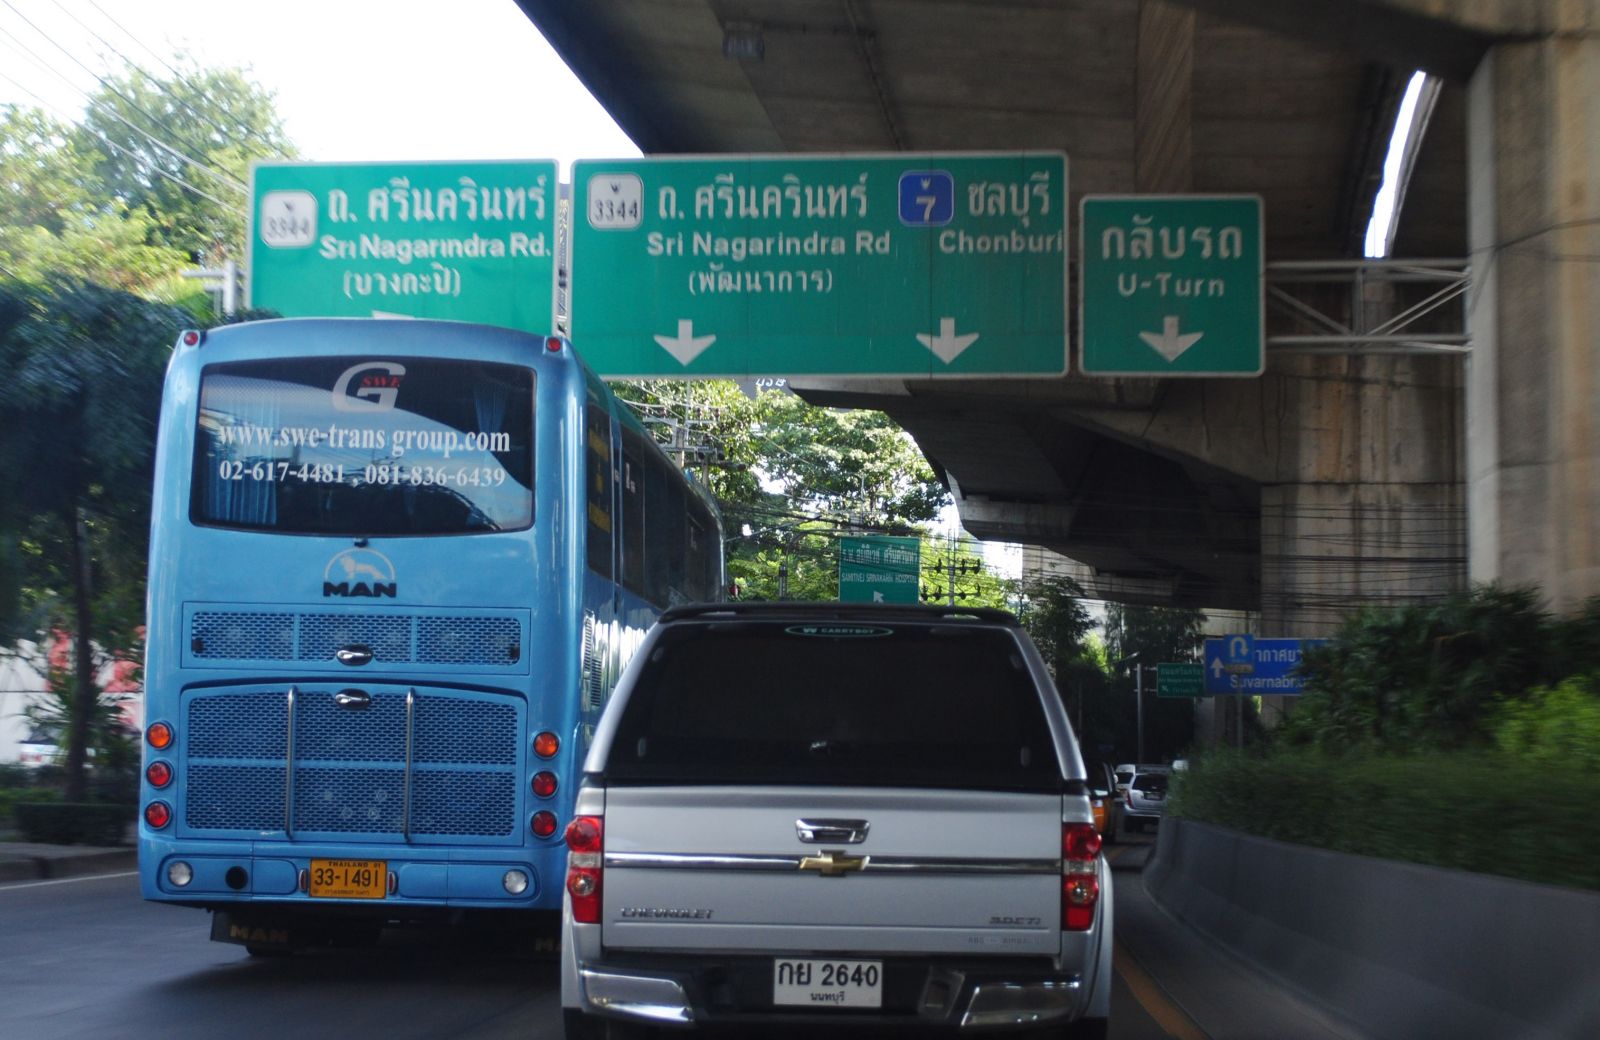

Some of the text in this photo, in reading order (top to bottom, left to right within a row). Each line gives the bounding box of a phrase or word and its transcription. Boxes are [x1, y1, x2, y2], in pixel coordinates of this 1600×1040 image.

[328, 174, 547, 223] ถ. ศรีนครินทร์
[595, 199, 639, 221] 3344
[658, 172, 868, 220] ถ. ศรีนครินทร์
[915, 195, 937, 223] 7
[967, 170, 1051, 227] ชลบุรี
[266, 215, 310, 241] 3344
[939, 230, 1064, 254] Chonburi
[1102, 213, 1243, 260] กลับรถ
[319, 231, 551, 265] Sri Nagarindra Rd.
[647, 230, 890, 261] Sri Nagarindra Rd
[343, 261, 461, 299] (บางกะปิ)
[689, 261, 833, 295] (พัฒนาการ)
[1117, 272, 1225, 297] U-Turn
[219, 423, 511, 457] www.swe-trans group.com
[219, 459, 345, 484] 02-617-4481
[365, 463, 506, 488] 081-836-6439
[323, 582, 397, 598] MAN
[314, 868, 379, 888] 33-1491
[620, 907, 715, 919] CHEVROLET
[779, 962, 879, 987] กย 2640
